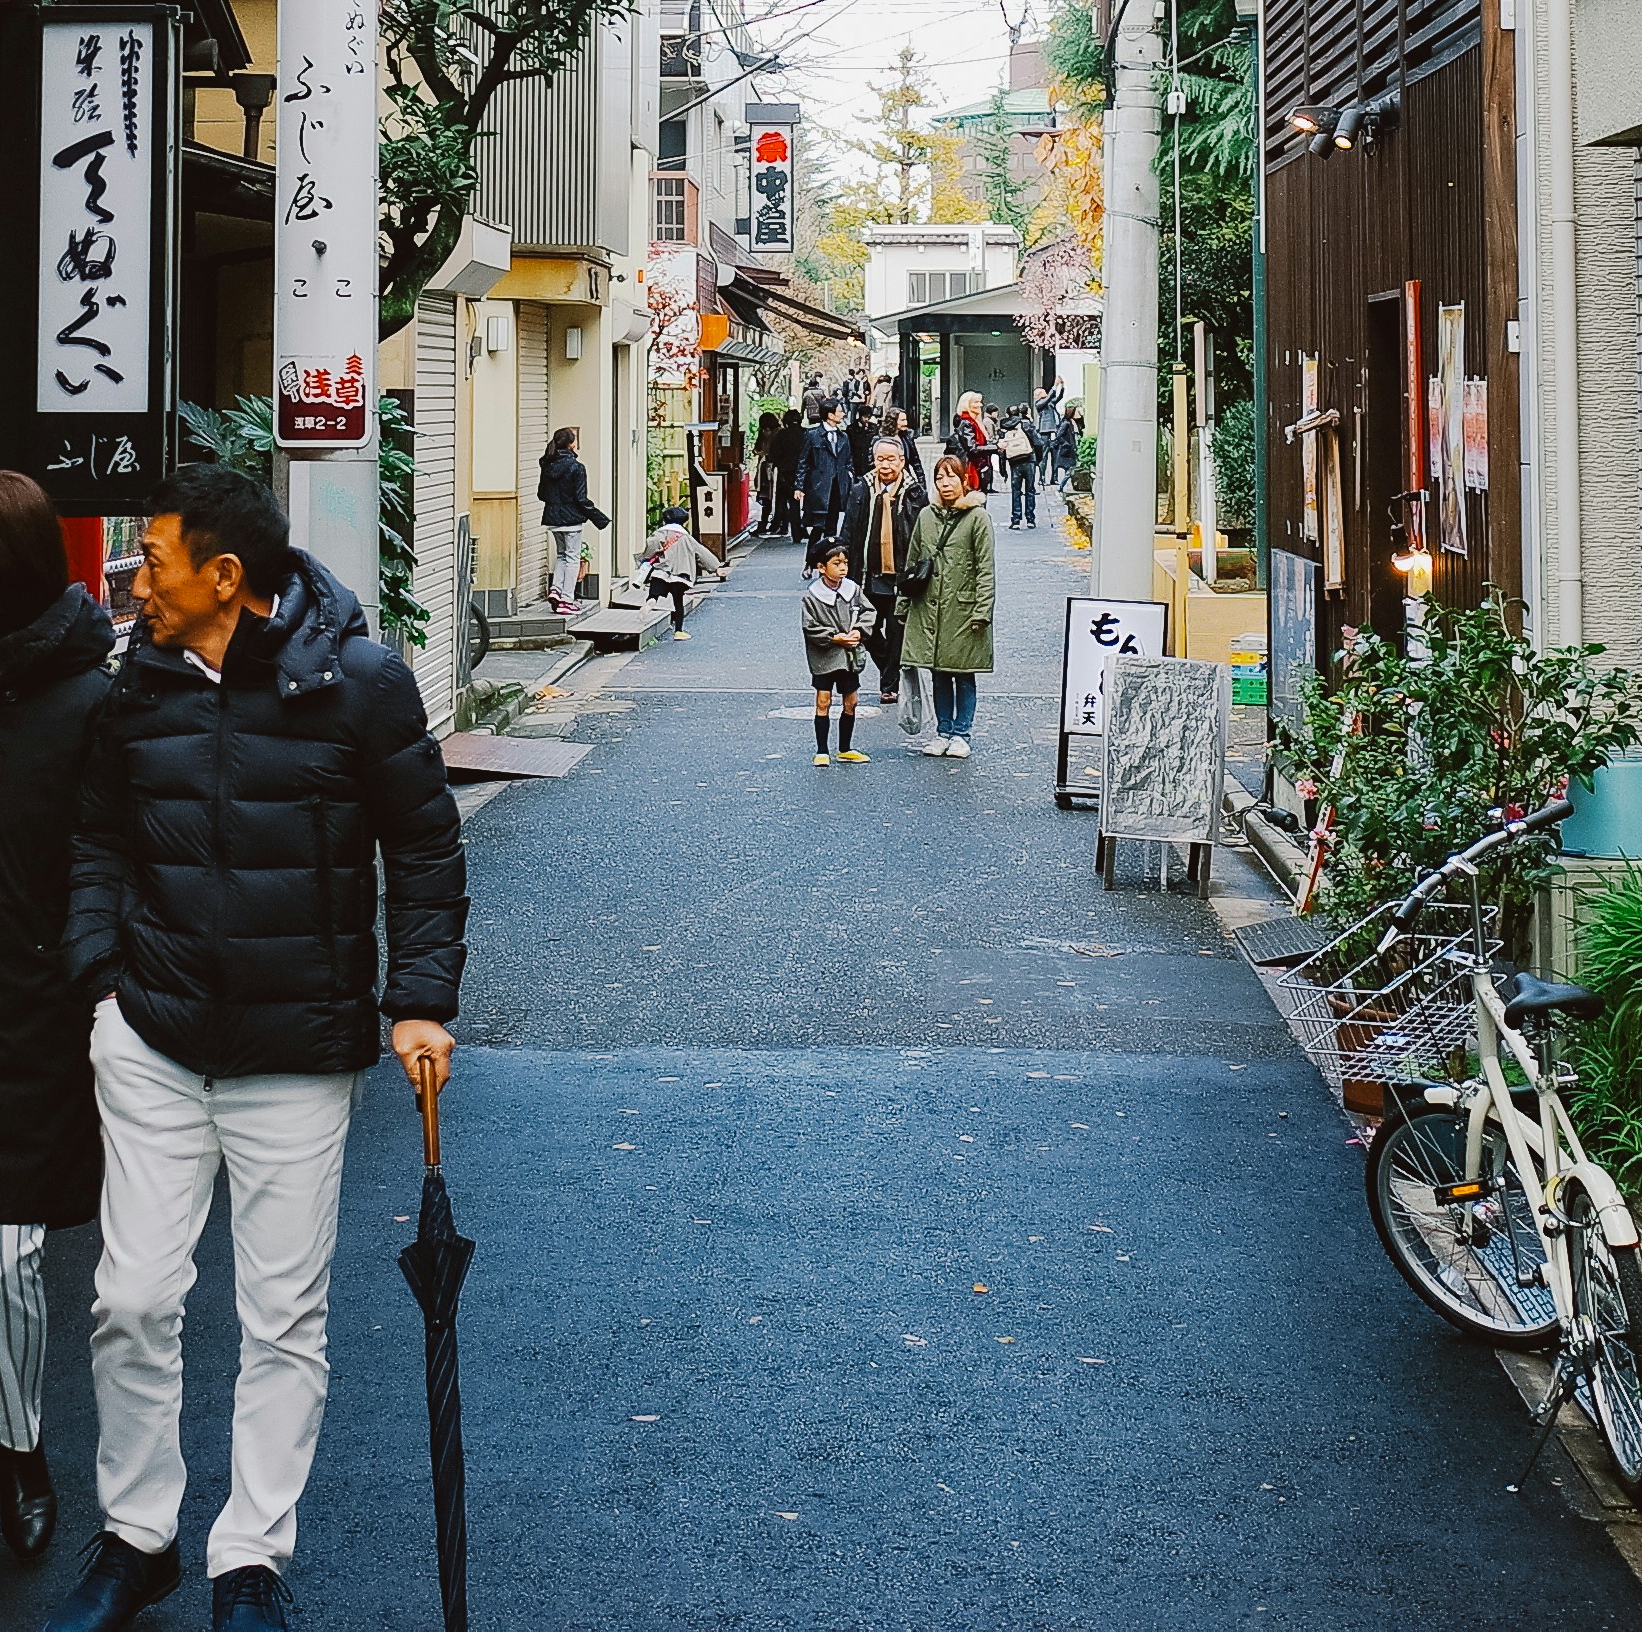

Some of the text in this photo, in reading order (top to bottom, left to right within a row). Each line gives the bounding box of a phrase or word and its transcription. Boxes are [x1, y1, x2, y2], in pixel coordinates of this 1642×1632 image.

[283, 55, 334, 227] ふじ屋
[303, 368, 360, 406] 浅草
[46, 433, 140, 480] ふじ屋
